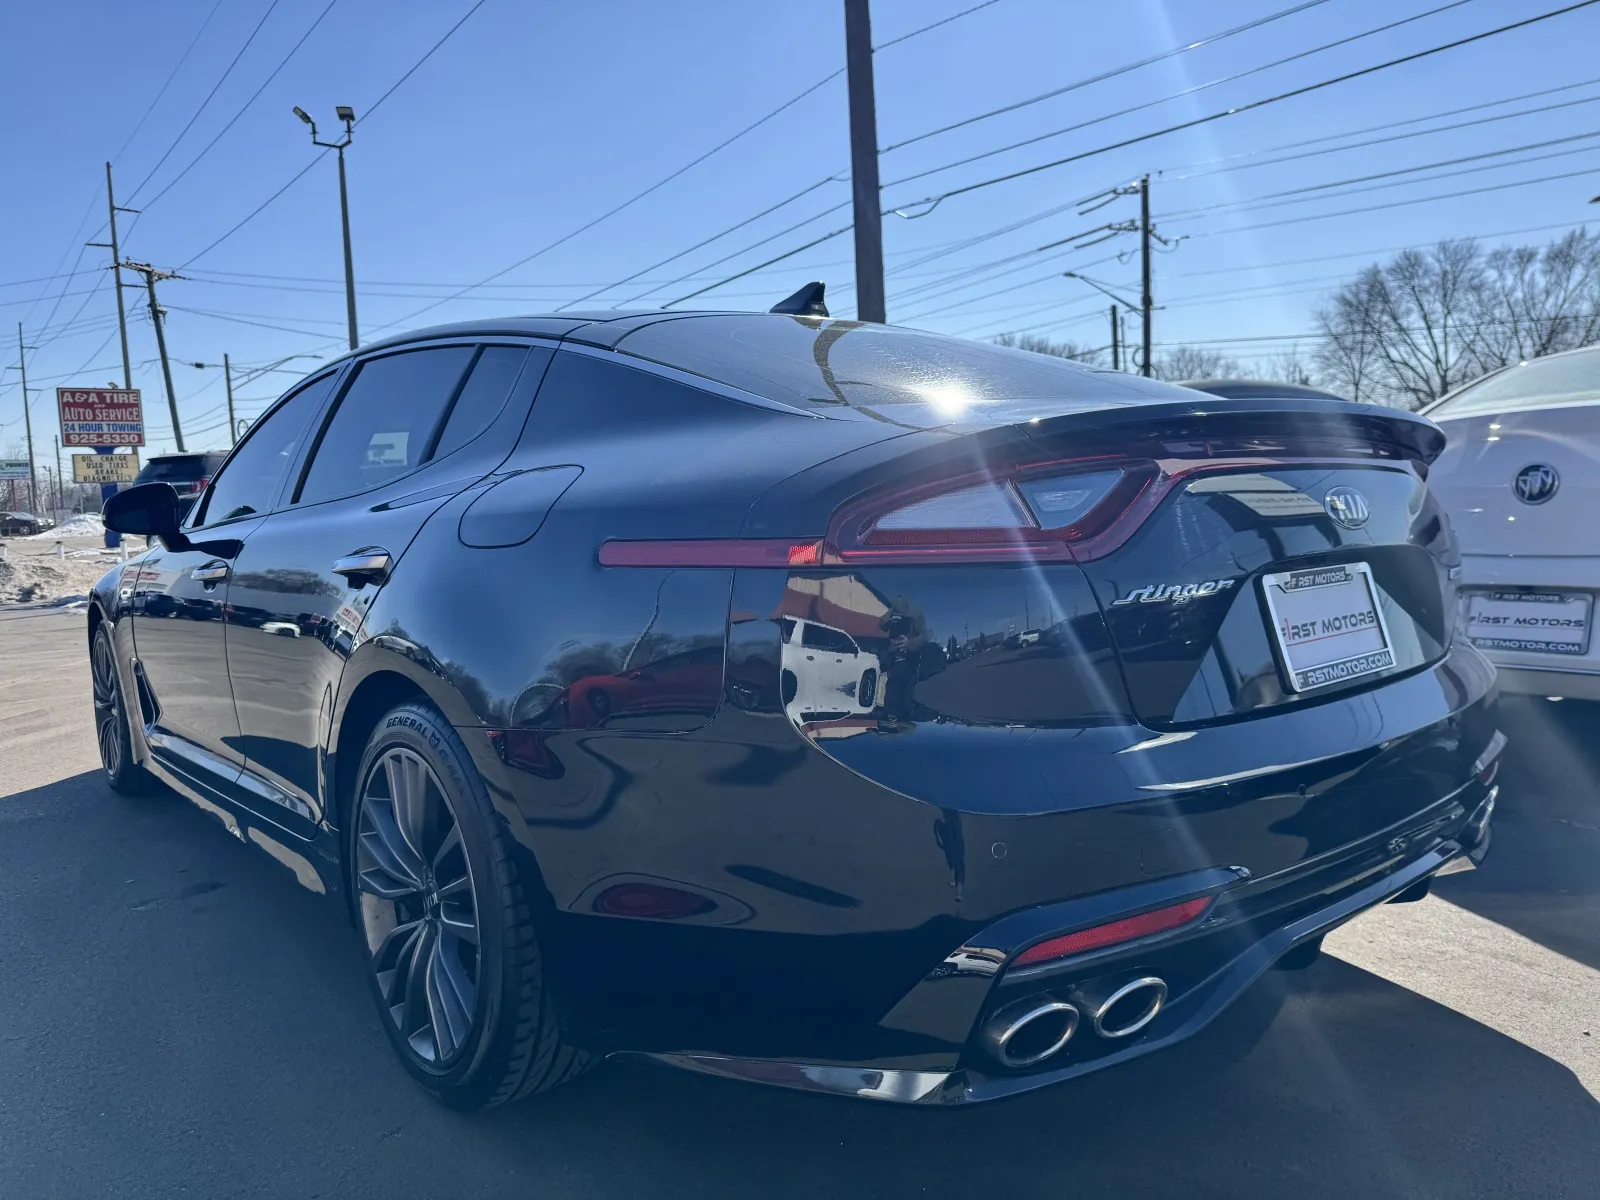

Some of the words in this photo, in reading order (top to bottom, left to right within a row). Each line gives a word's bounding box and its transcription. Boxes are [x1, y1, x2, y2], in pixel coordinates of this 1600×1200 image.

[62, 392, 99, 403] A&A
[102, 393, 138, 404] TIRE
[64, 407, 93, 421] AUTO
[95, 408, 140, 421] SERVICE
[63, 423, 76, 432] 24
[78, 423, 104, 432] HOUR
[106, 423, 141, 432] TOWING
[69, 434, 139, 444] 925-5330
[1331, 494, 1368, 520] KIA
[1291, 575, 1315, 588] FRST
[1315, 571, 1346, 585] MOTORS
[1521, 594, 1560, 602] MOTORS
[1322, 610, 1375, 634] MOTORS
[1513, 617, 1585, 627] MOTORS
[1296, 652, 1392, 687] FRSTMOTOR.COM
[386, 715, 428, 738] GENERAL
